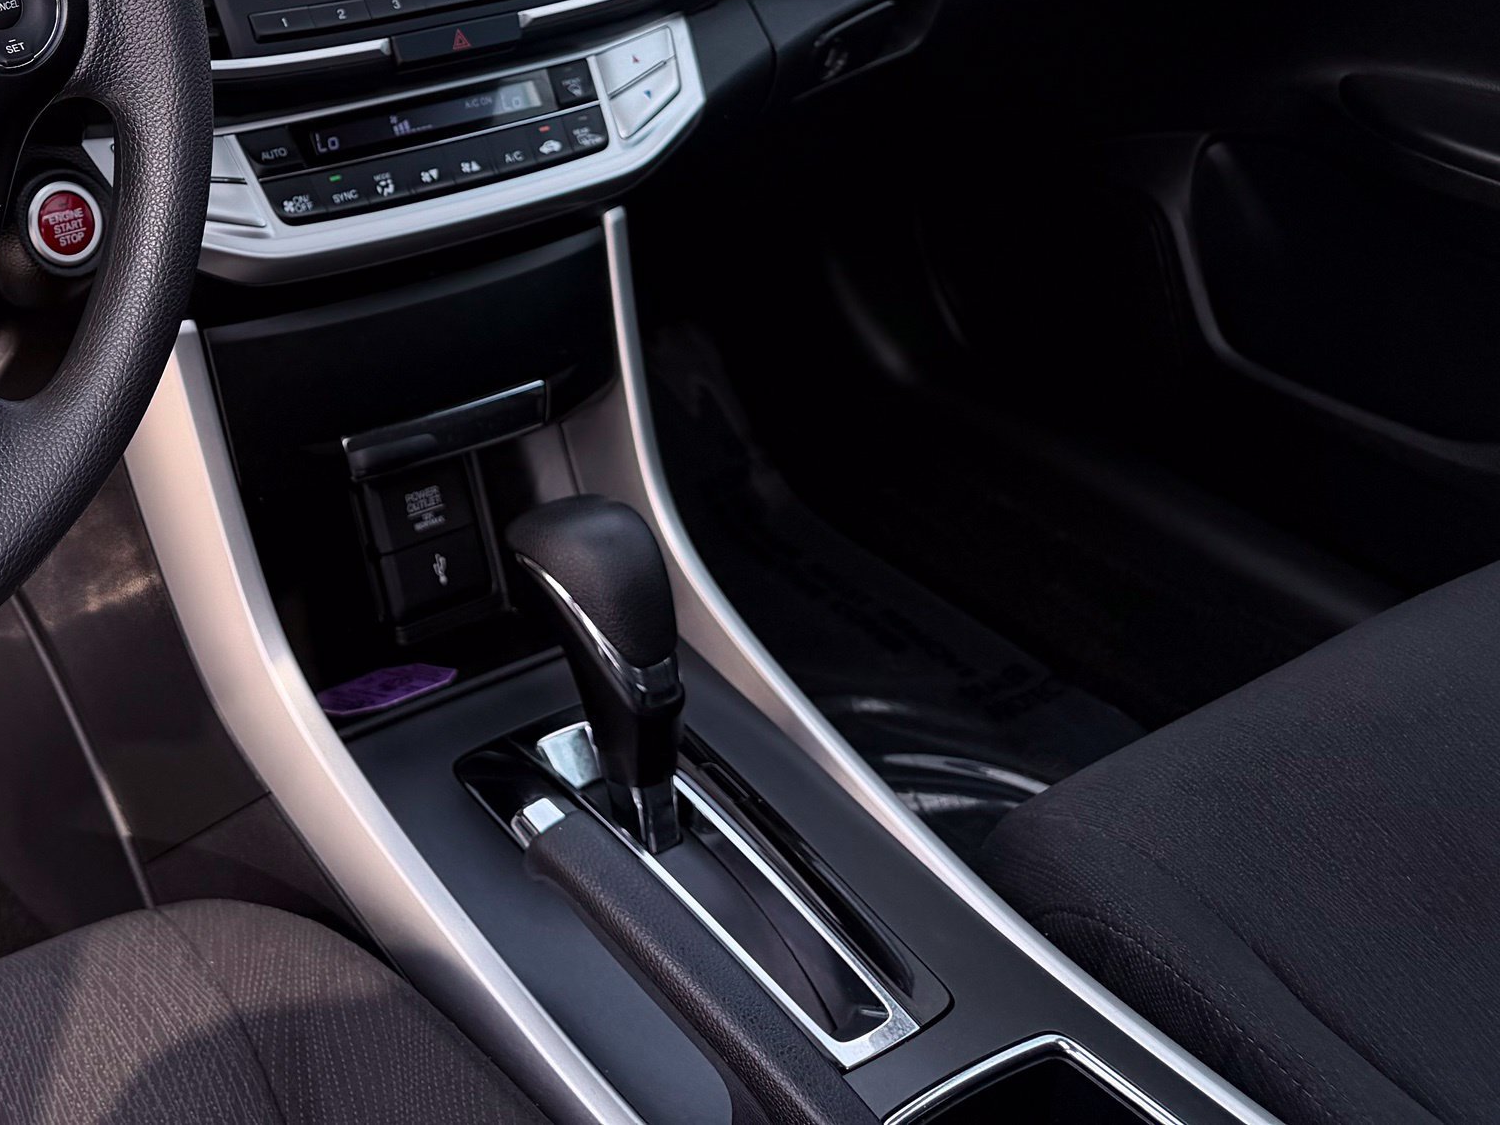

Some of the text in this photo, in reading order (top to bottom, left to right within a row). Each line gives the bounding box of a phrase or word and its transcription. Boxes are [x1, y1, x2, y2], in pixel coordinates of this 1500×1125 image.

[336, 8, 346, 21] 2
[281, 17, 289, 28] 1
[5, 43, 25, 55] SET
[316, 131, 341, 153] Lo
[260, 146, 288, 161] AUTO
[504, 150, 525, 164] A/C
[332, 188, 359, 204] SYNC
[49, 207, 84, 225] ENGINE
[54, 218, 84, 235] START
[59, 233, 85, 247] STOP
